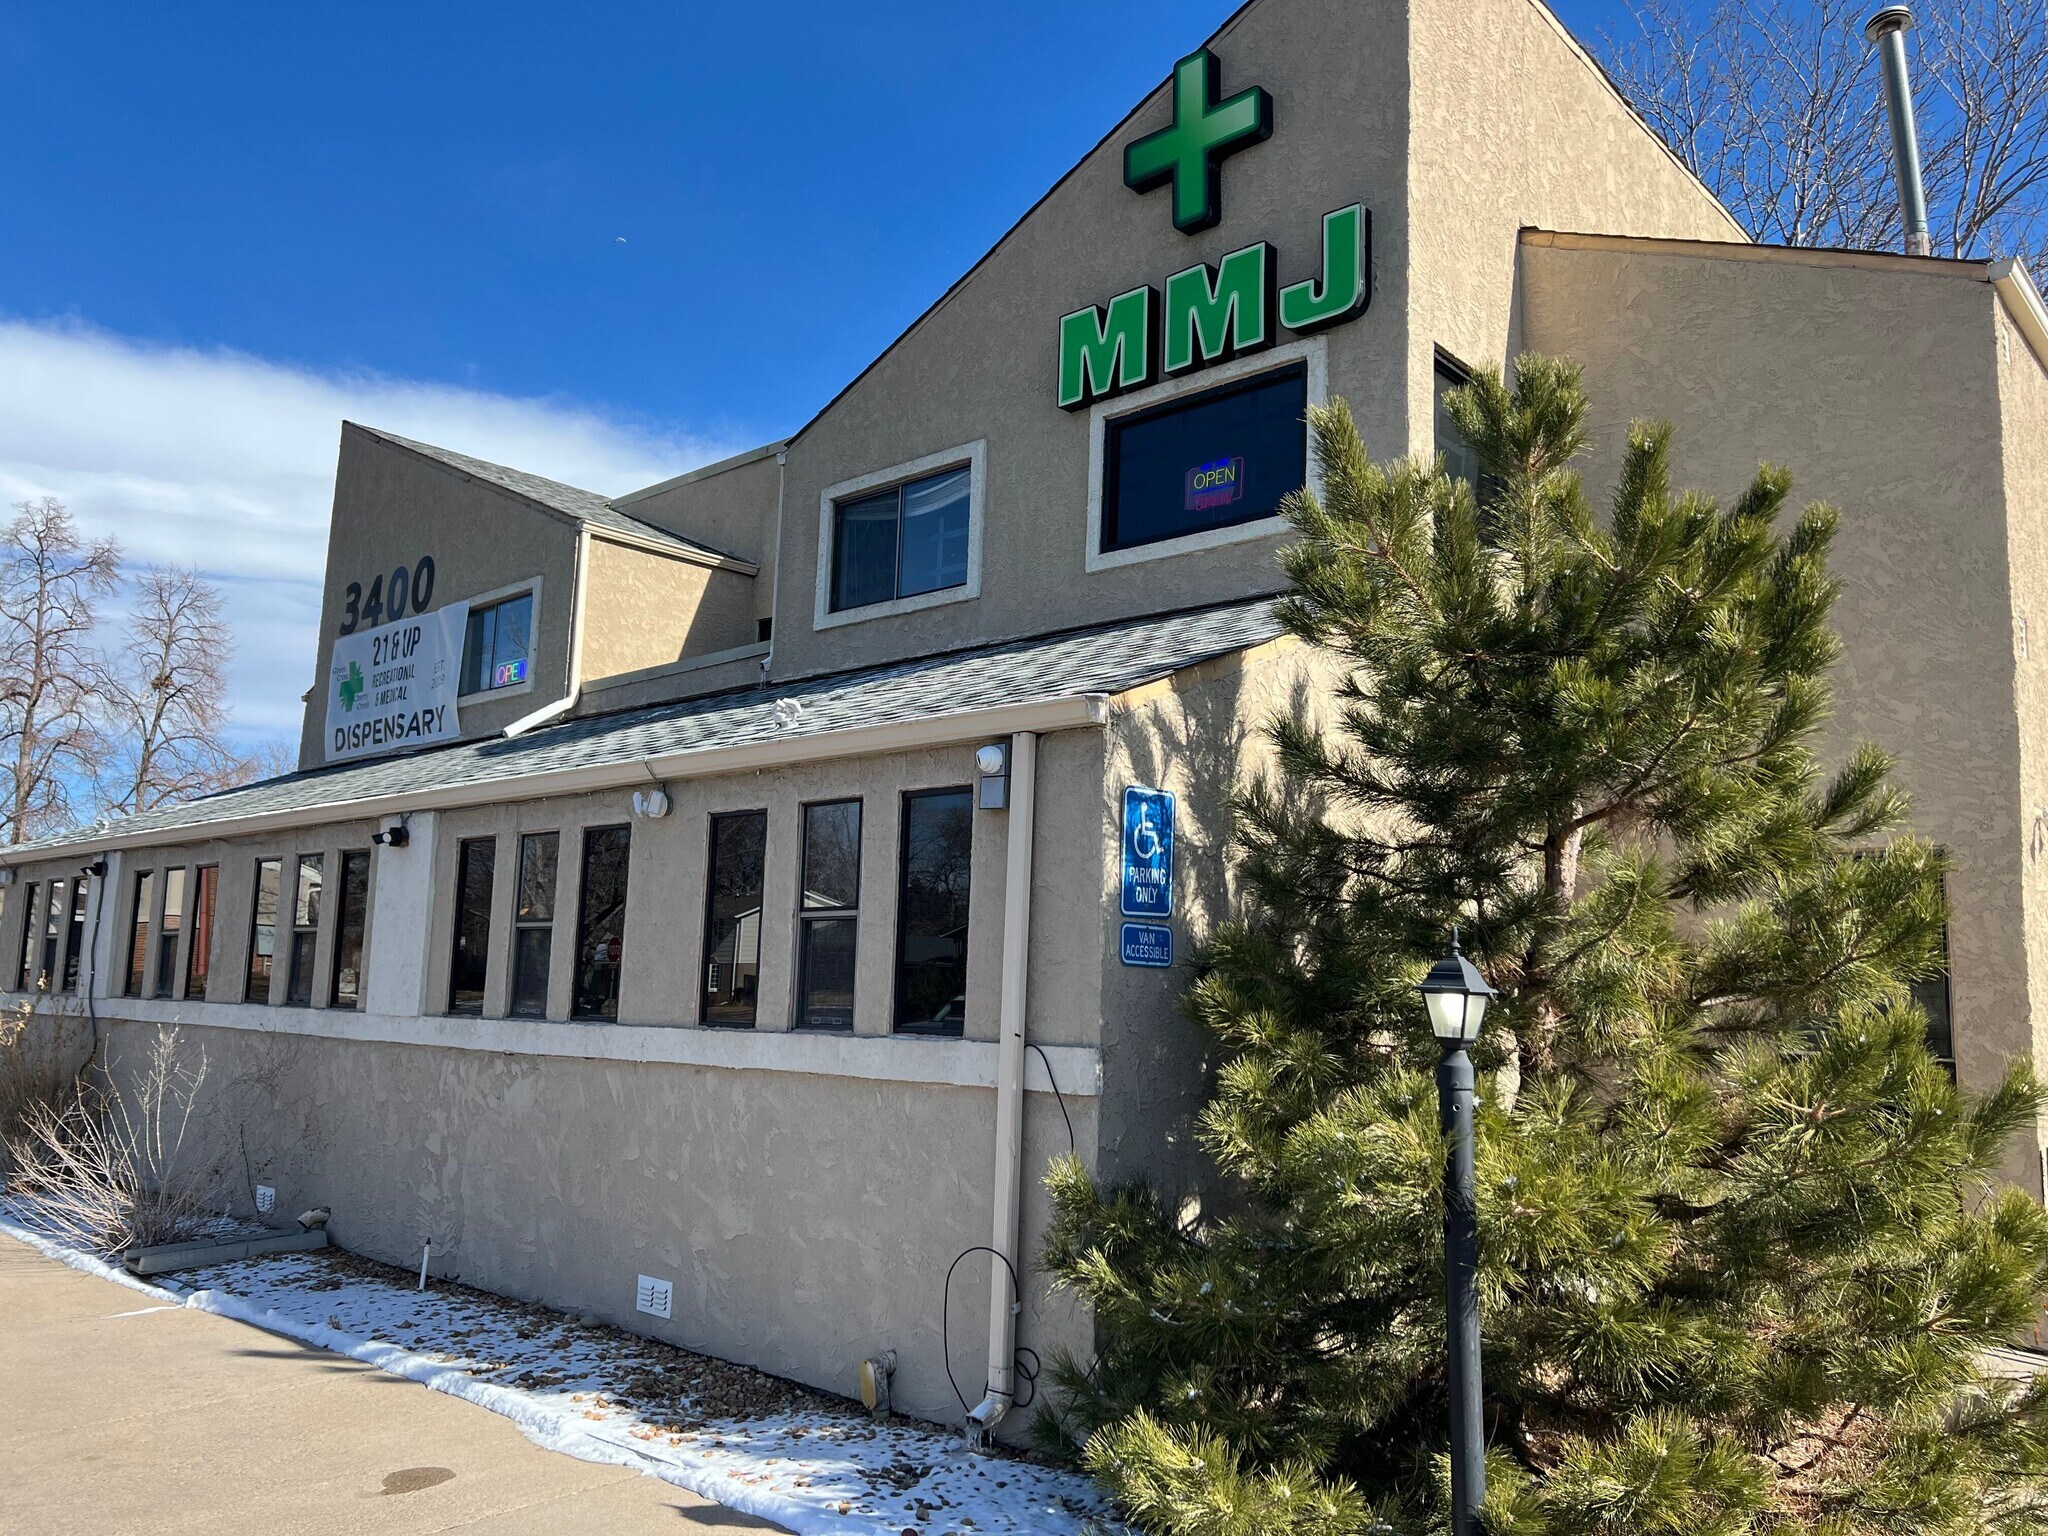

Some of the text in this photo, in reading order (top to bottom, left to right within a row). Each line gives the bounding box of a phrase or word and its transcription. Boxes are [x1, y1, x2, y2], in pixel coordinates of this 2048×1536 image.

[1057, 202, 1368, 411] MMJ
[1193, 465, 1236, 490] OPEN
[339, 555, 435, 637] 3400
[373, 626, 421, 667] 21 & UP
[371, 663, 415, 688] RECREATIONAL
[497, 661, 527, 684] OPEN
[380, 686, 407, 705] MEDICAL
[335, 705, 446, 753] DISPENSARY
[1129, 866, 1167, 885] PARKING
[1135, 886, 1158, 903] ONLY
[1138, 931, 1156, 945] VAN
[1125, 944, 1169, 960] ACCESSIBLE
